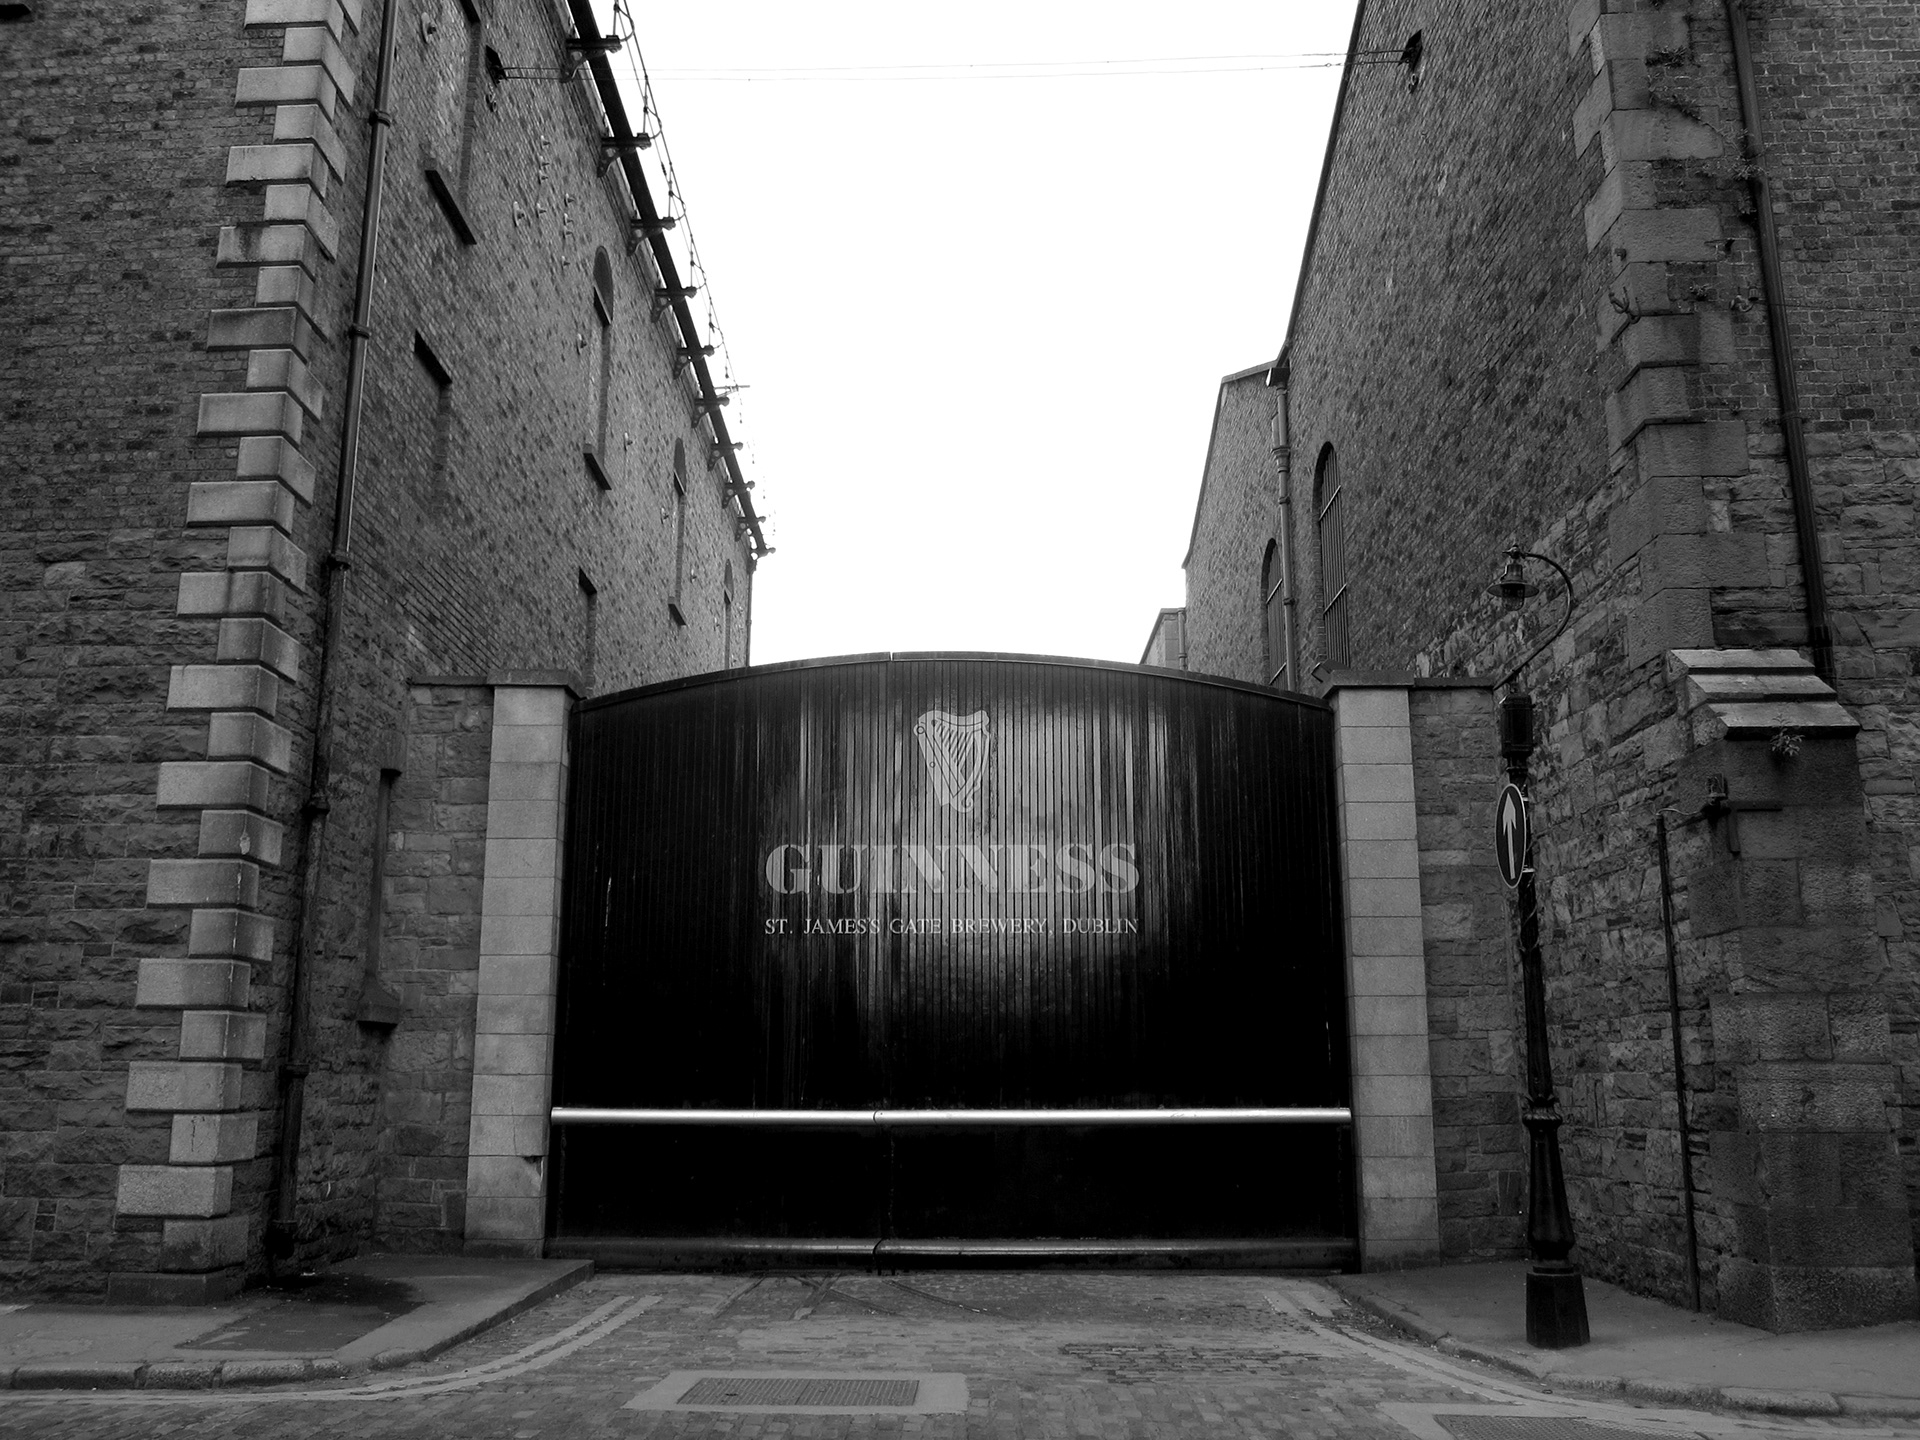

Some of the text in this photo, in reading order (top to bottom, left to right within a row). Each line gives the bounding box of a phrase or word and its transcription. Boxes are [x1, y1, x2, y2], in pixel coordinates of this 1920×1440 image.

[765, 843, 1140, 895] GUINNESS
[764, 918, 793, 935] ST.
[889, 918, 942, 935] GATE
[951, 918, 1054, 937] BREWERY,
[1062, 918, 1140, 935] DUBLIN
